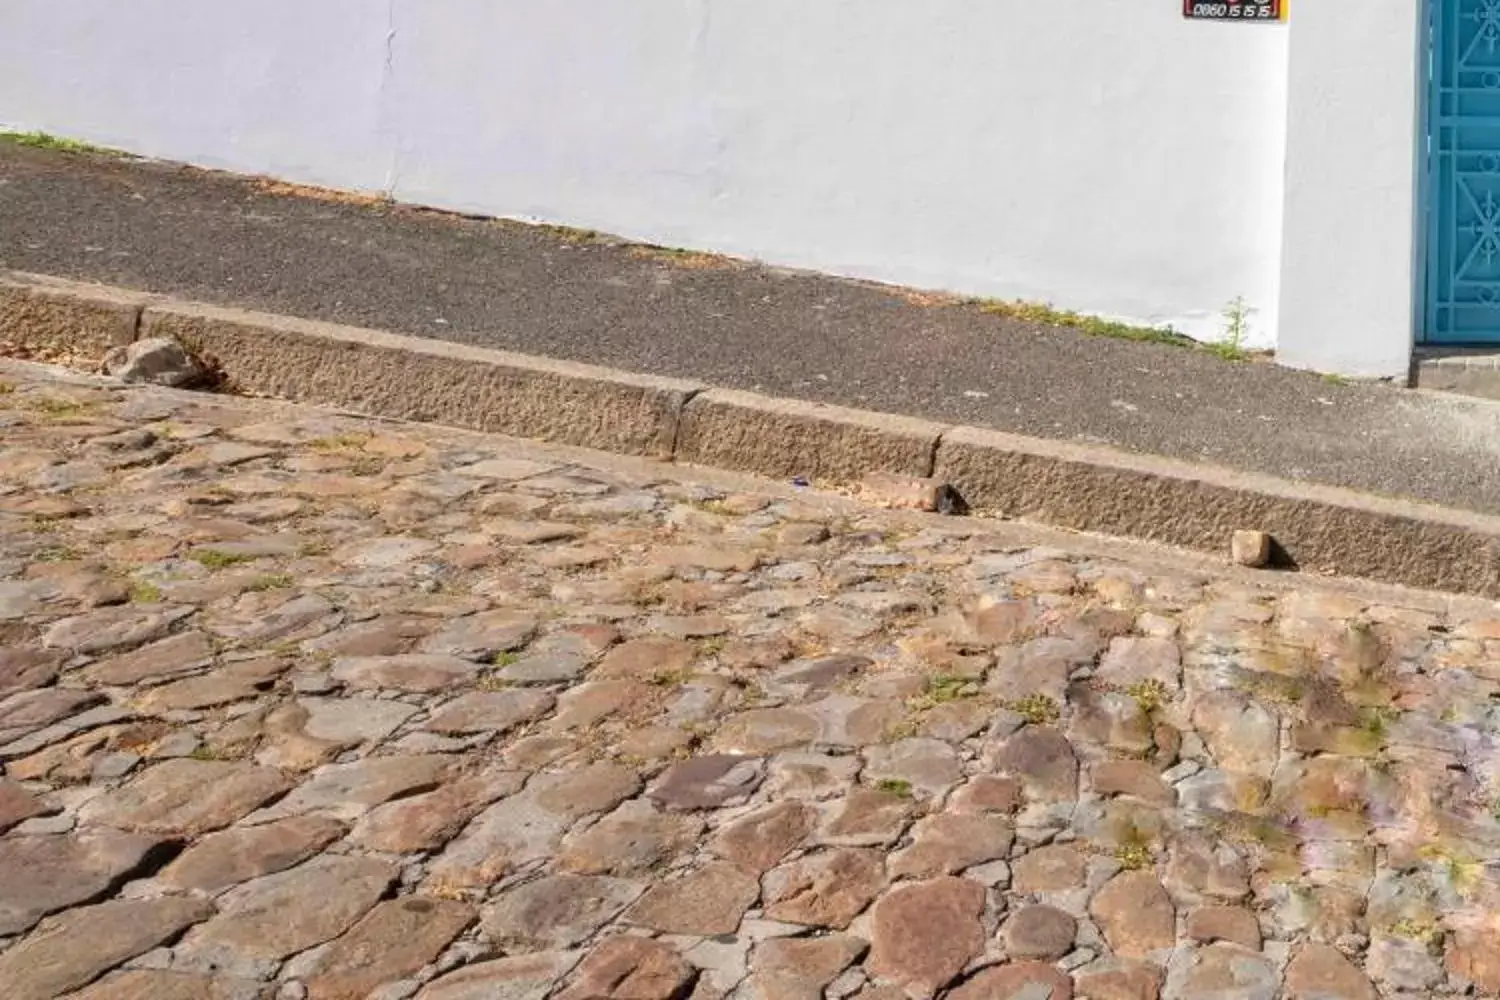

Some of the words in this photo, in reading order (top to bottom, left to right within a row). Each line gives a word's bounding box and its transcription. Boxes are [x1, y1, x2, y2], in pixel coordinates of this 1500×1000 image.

[1193, 3, 1227, 17] 0860
[1228, 5, 1242, 17] 15
[1243, 5, 1257, 17] 15
[1258, 5, 1271, 17] 15
